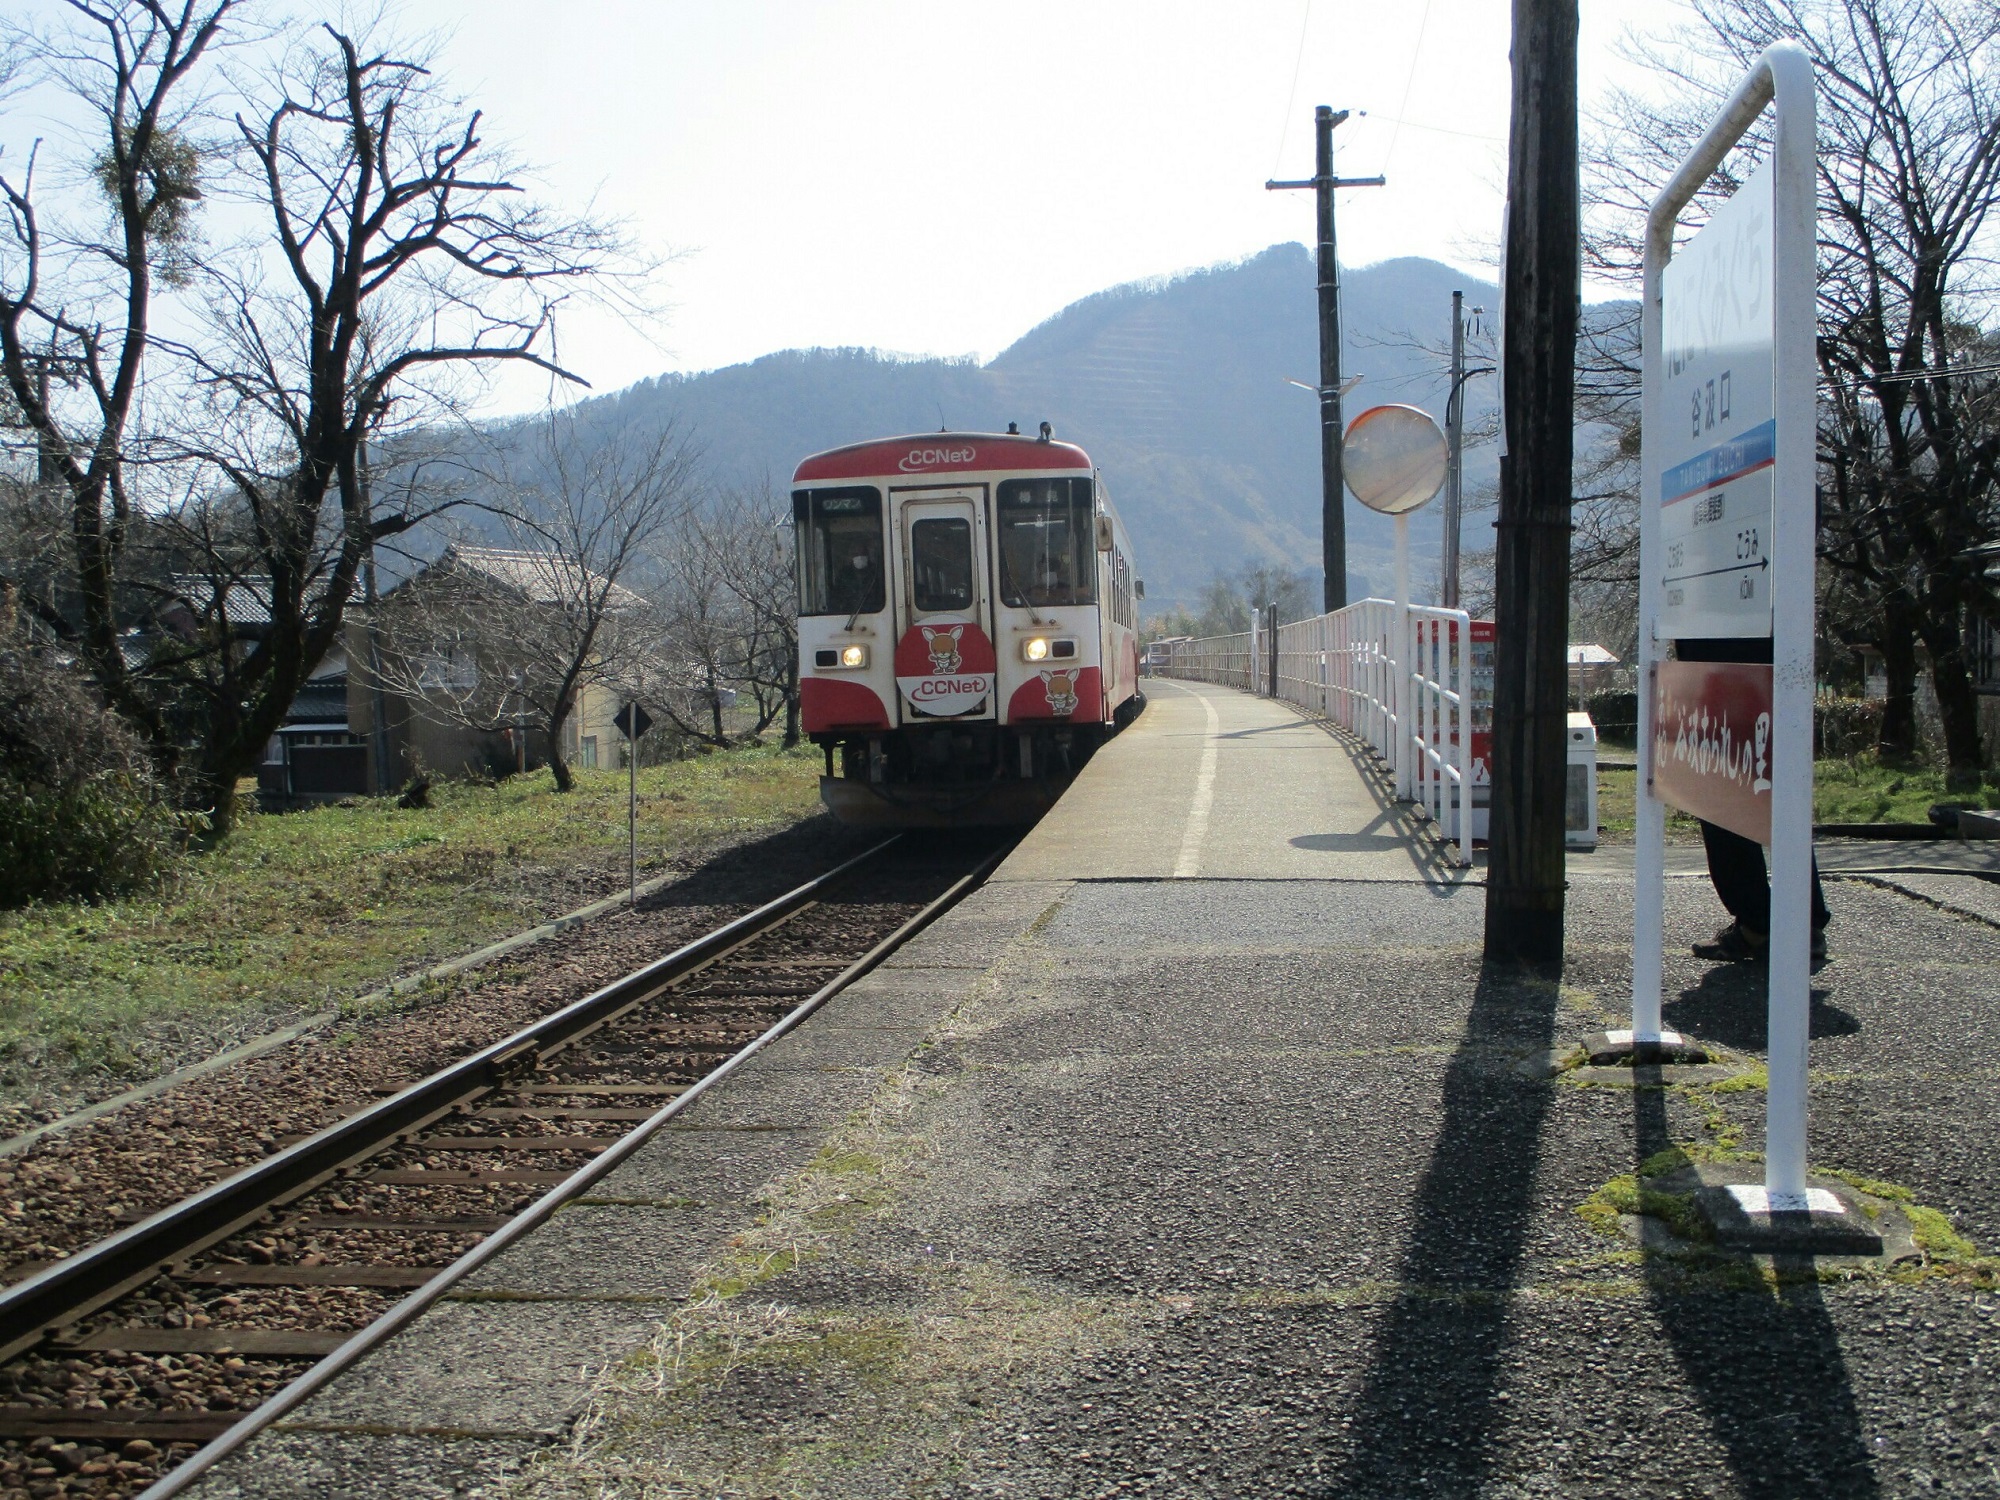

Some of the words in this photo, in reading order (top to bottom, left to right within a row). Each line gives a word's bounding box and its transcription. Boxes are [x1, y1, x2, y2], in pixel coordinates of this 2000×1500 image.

[1668, 206, 1763, 379] たにぐみぐち
[1691, 369, 1731, 440] 谷汲口
[906, 447, 973, 466] CCNet
[920, 679, 983, 696] CCNet
